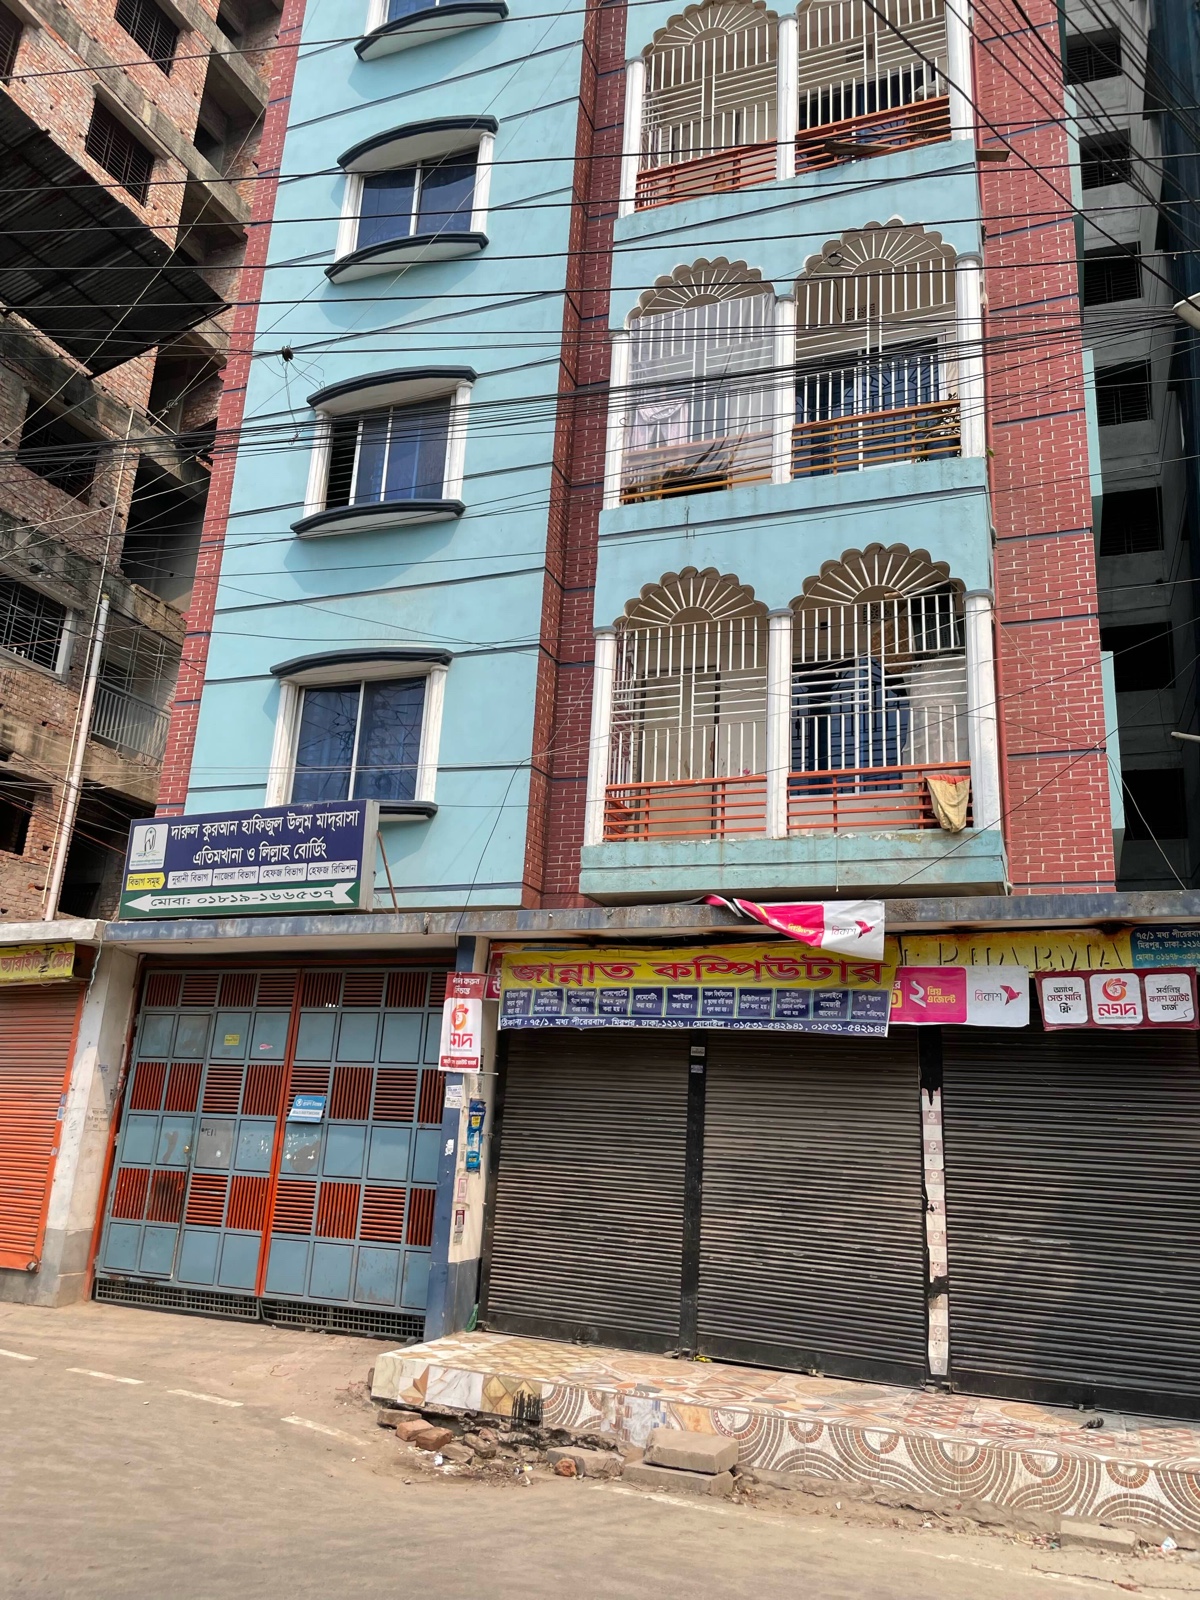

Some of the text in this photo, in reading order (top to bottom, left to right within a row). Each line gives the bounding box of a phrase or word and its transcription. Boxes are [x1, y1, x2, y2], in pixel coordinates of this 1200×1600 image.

[171, 824, 200, 840] দারুল
[202, 820, 239, 842] কুরআন
[241, 814, 284, 836] হাফিজুল
[287, 811, 313, 834] উলুম
[193, 836, 327, 865] এতিমখানা ও লিল্লাহ বোর্ডিং
[238, 869, 256, 879] বিভাগ
[263, 866, 304, 878] হেফজ বিভাগ
[309, 866, 329, 876] হেফজ
[128, 876, 145, 886] বিভাগ
[191, 873, 209, 883] বিভাগ
[197, 890, 334, 904] ০১৮১৯-১৬৬৫৩৭
[832, 926, 856, 936] বিকাশ
[1136, 931, 1154, 940] ৭৫/১
[508, 962, 641, 986] জান্নাত
[646, 954, 891, 985] কম্পিউটার
[909, 980, 926, 1008] ২
[927, 986, 942, 995] প্রিয়
[927, 994, 956, 1004] এজেন্টে
[975, 989, 1002, 1001] বিকাশ
[1065, 992, 1082, 1002] মানি
[1169, 993, 1190, 1002] আউট
[1098, 1002, 1137, 1016] নগদ
[1162, 1003, 1178, 1011] চার্জ
[501, 1017, 522, 1026] ঠিকানা
[692, 1019, 726, 1028] মোবাইল
